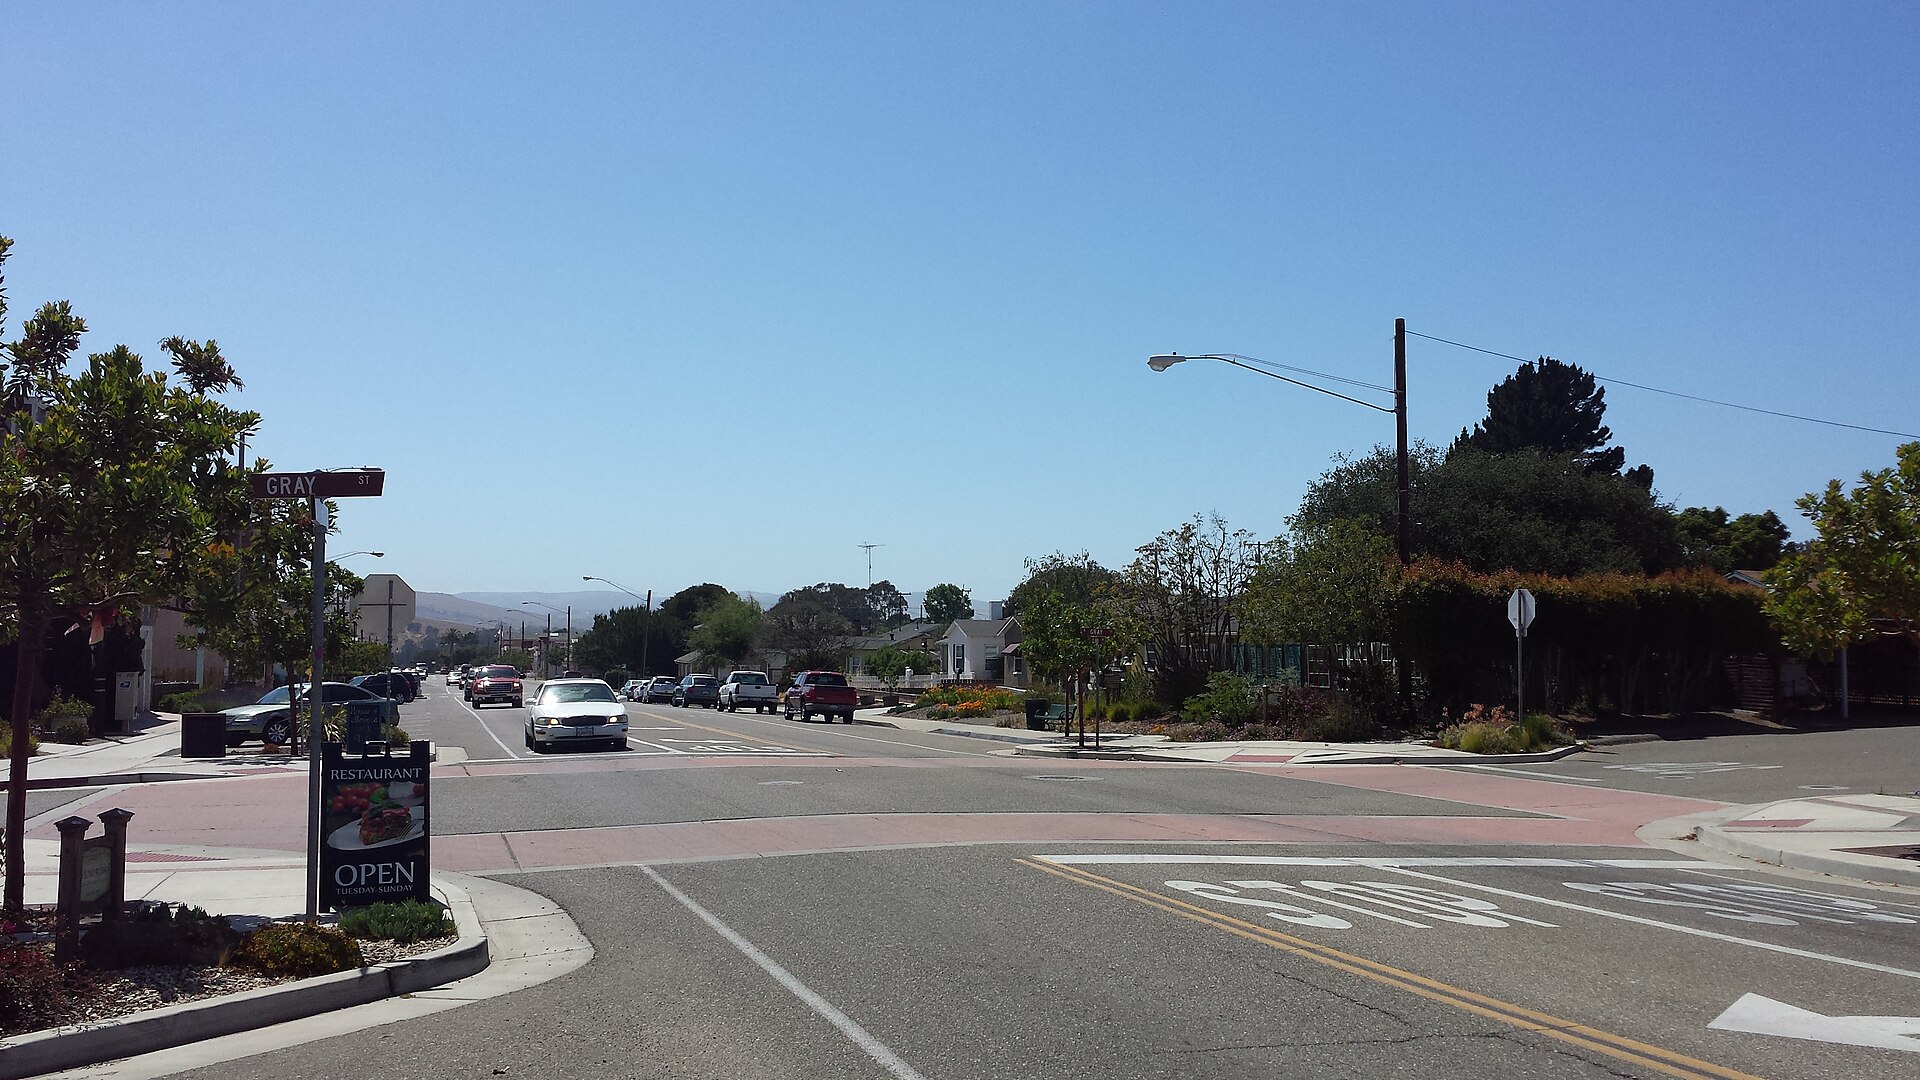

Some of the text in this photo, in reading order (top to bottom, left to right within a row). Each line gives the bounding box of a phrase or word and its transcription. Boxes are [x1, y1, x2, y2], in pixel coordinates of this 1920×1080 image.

[266, 475, 370, 495] GRAY ST
[330, 768, 422, 780] RESTAURANT
[334, 861, 414, 887] OPEN
[336, 884, 414, 895] TUESDAY-SUNDAY
